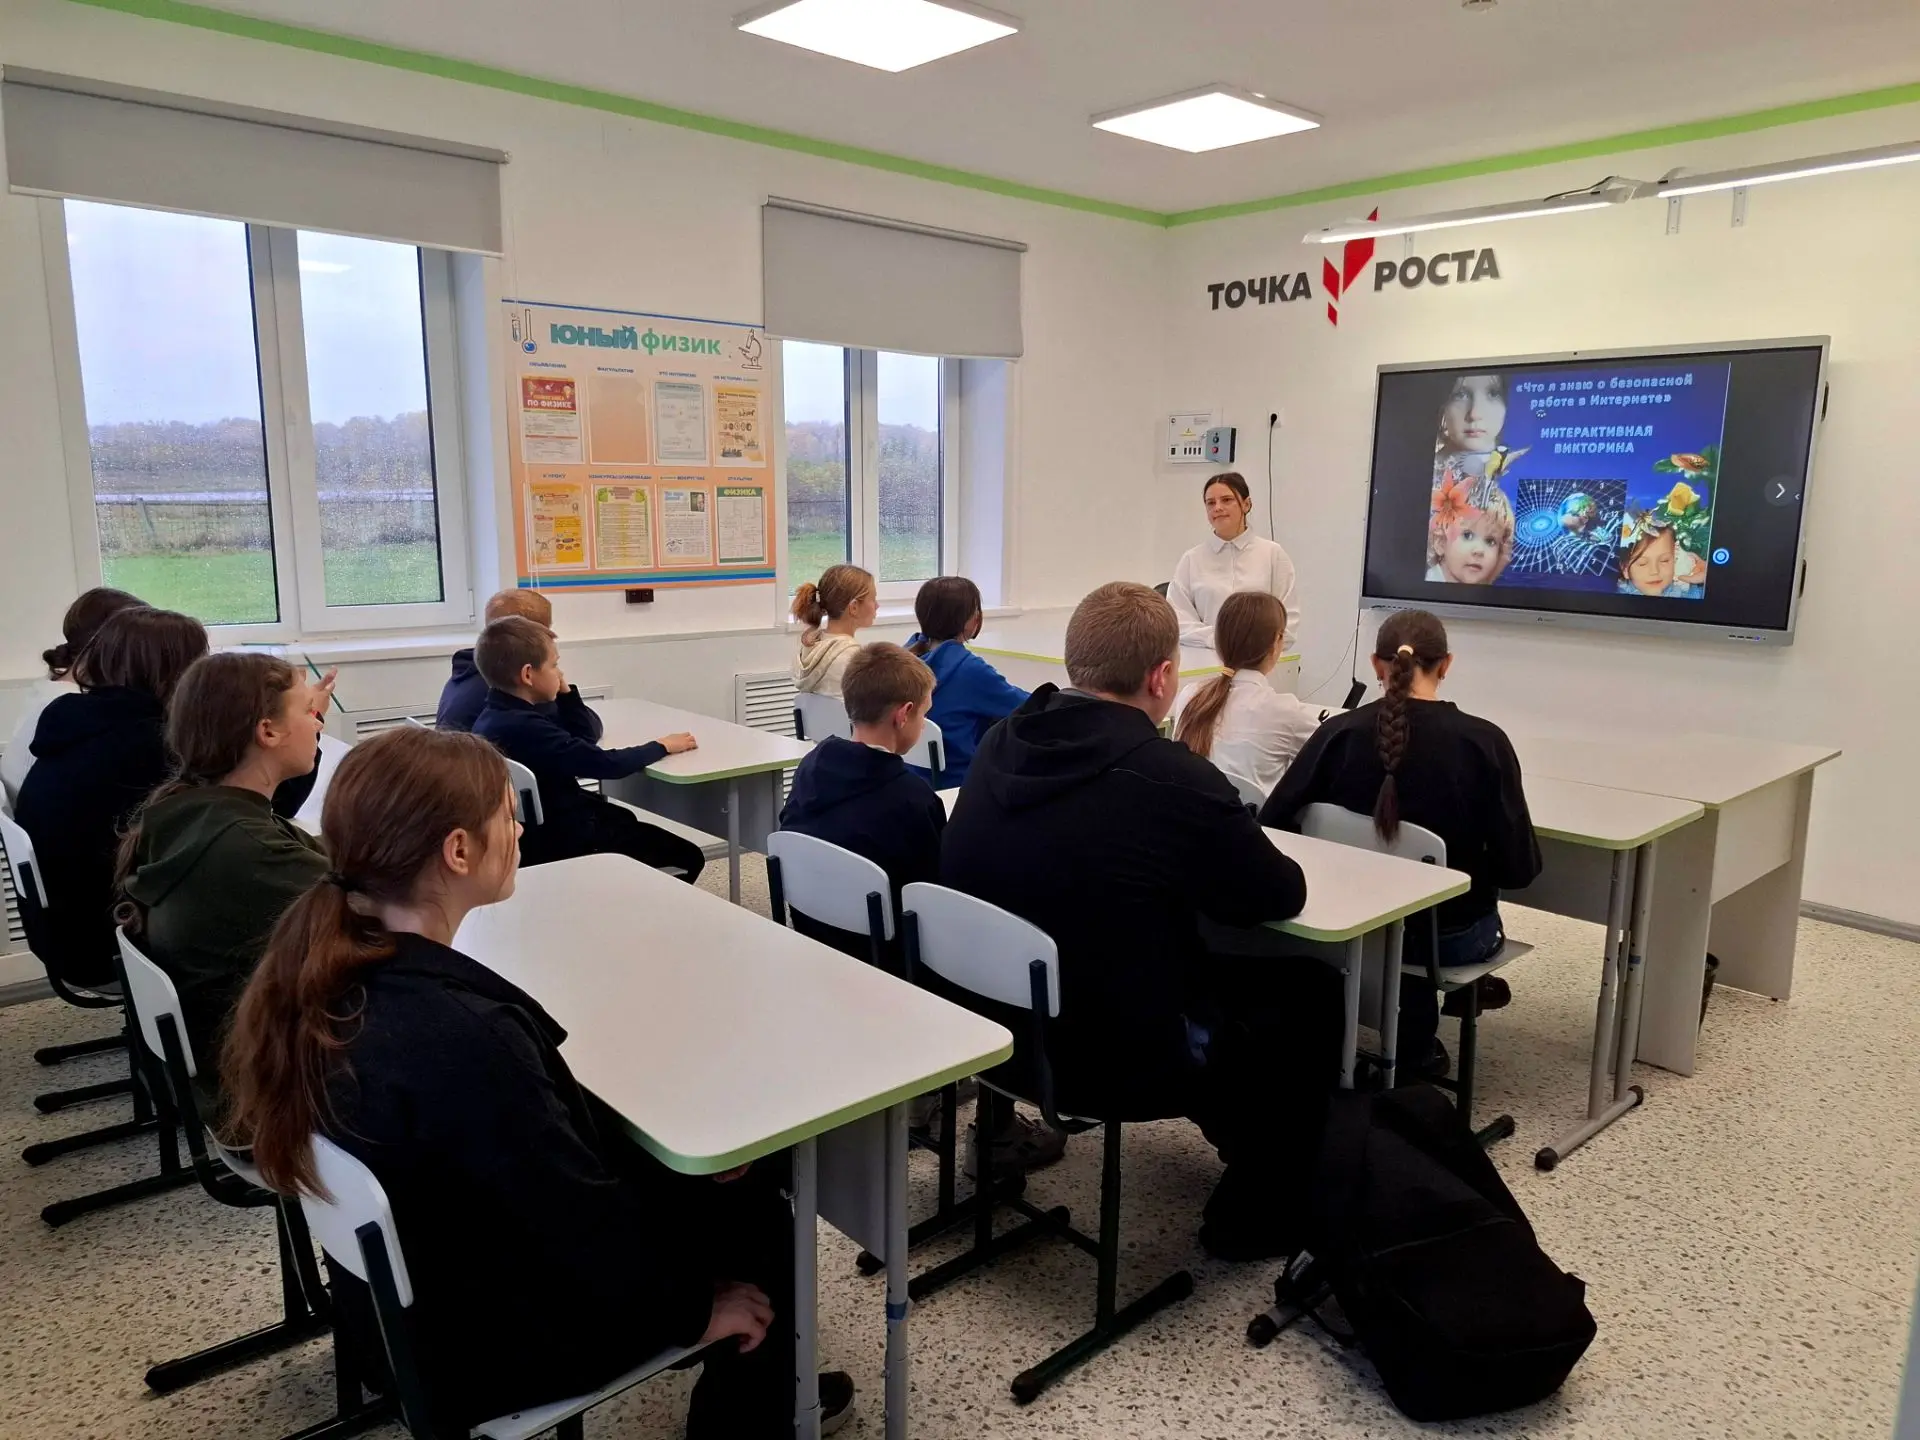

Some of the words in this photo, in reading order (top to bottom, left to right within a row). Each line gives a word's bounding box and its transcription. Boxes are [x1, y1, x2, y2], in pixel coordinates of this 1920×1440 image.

[1207, 271, 1312, 311] ТОЧКА
[1373, 247, 1501, 292] РОСТА
[550, 323, 639, 350] ЮНЫЙ
[641, 327, 722, 356] физик
[1516, 380, 1545, 393] «Что
[1548, 384, 1556, 392] я
[1560, 381, 1594, 391] знаю
[1597, 381, 1605, 390] о
[1610, 373, 1694, 389] безопасной
[540, 400, 573, 409] ФИЗИКЕ
[1530, 396, 1575, 410] работе
[1579, 398, 1586, 406] в
[1590, 394, 1672, 408] Интернете»
[1540, 425, 1654, 439] ИНТЕРАКТИВНАЯ
[1554, 442, 1635, 454] ВИКТОРИНА
[723, 488, 757, 497] ФИЗИКА
